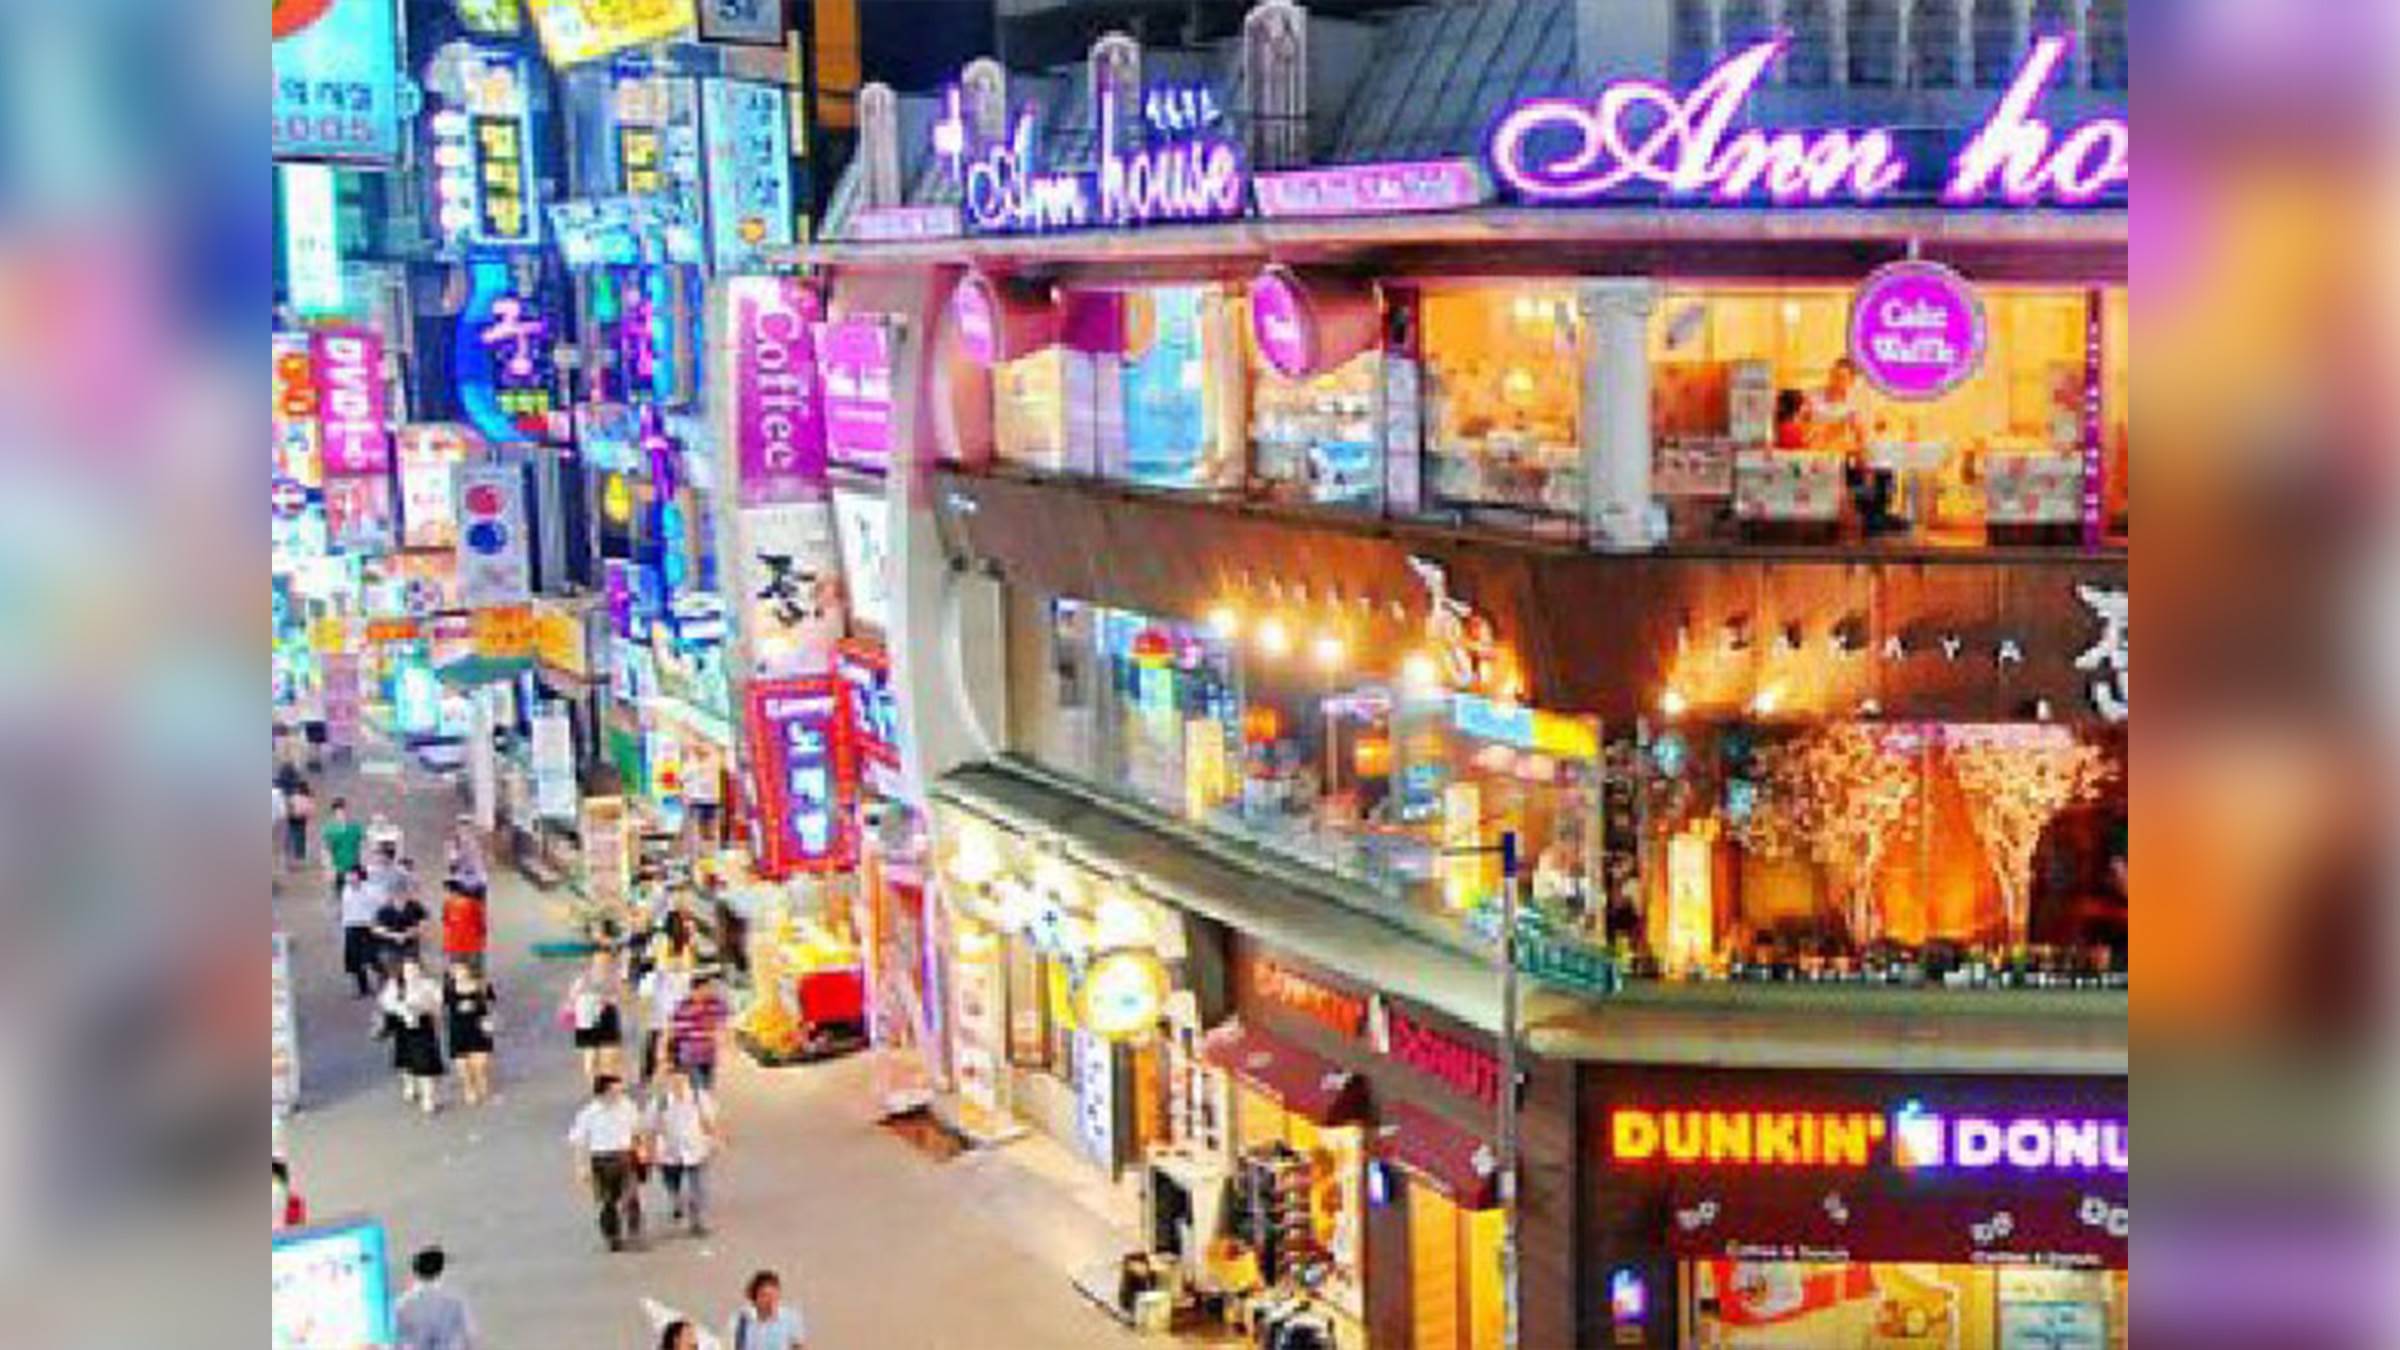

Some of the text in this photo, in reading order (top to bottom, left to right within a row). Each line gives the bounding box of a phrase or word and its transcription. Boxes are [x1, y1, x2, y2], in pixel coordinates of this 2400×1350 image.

[1490, 28, 2128, 202] Ann ho
[1880, 300, 1949, 330] Cake
[1870, 335, 1958, 366] Waffle
[754, 309, 810, 470] Coffee
[1611, 1108, 1886, 1166] DUNKIN'
